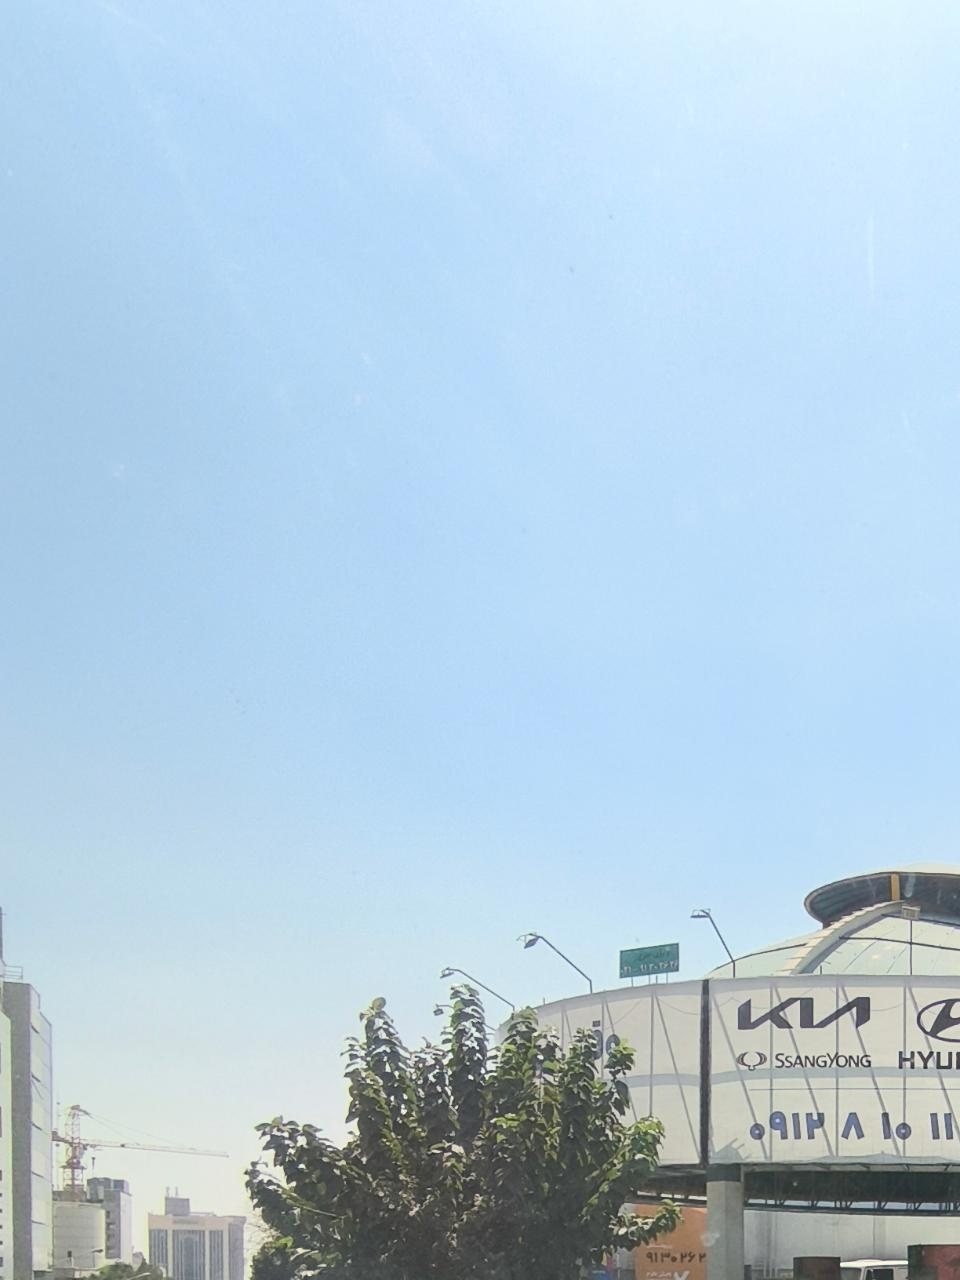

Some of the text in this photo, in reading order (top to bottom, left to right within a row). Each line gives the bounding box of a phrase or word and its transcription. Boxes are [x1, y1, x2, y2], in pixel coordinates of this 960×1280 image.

[737, 996, 871, 1030] KIA
[775, 1052, 871, 1068] SSANGYONG
[750, 1111, 825, 1140] ۰۹۱۲
